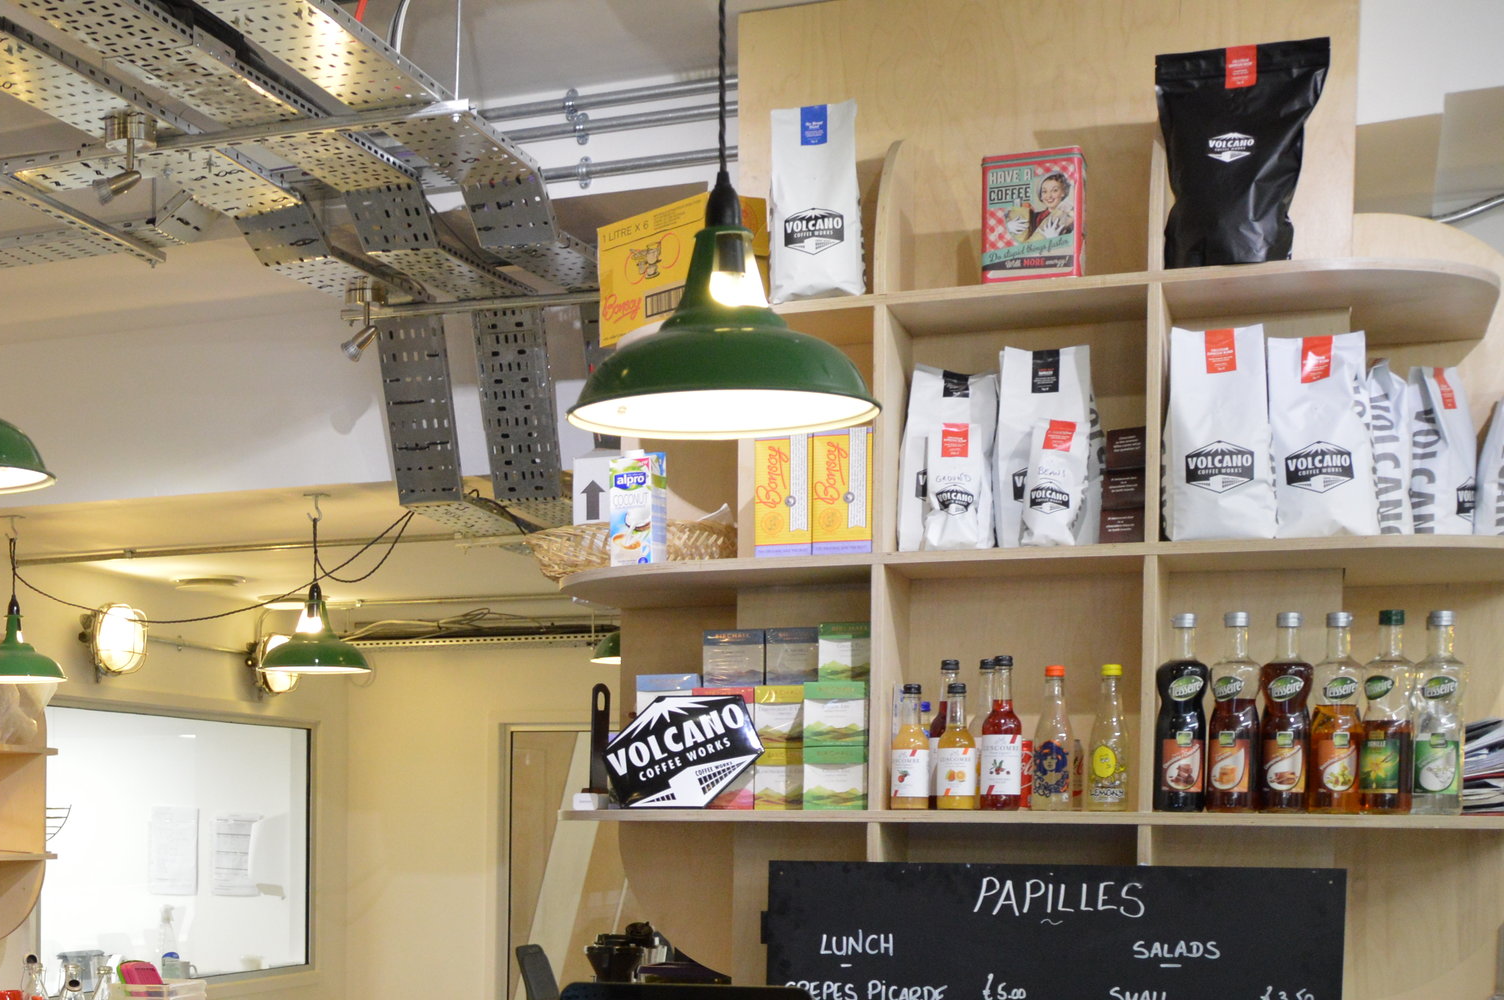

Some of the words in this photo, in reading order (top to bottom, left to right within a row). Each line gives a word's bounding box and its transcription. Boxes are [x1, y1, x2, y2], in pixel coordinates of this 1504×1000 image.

[1208, 138, 1254, 149] VOLCANO
[989, 169, 1020, 184] HAVE
[1023, 168, 1032, 180] A
[989, 186, 1031, 201] COFFEE
[785, 216, 843, 232] VOLCANO
[609, 227, 633, 243] LITRE
[814, 229, 834, 237] WORKS
[1023, 258, 1045, 267] MORE
[1187, 454, 1253, 470] VOLCANO
[1287, 453, 1351, 470] VOLCANO
[755, 445, 789, 509] Bonsoy
[813, 440, 848, 505] Bonsoy
[1221, 466, 1242, 474] WORKS
[1298, 468, 1321, 476] COFFEE
[1321, 466, 1343, 474] WORKS
[616, 473, 644, 487] alpro
[612, 493, 649, 507] COCONUT
[1031, 490, 1069, 502] VOLCANO
[1169, 678, 1205, 696] Teisseire
[1268, 678, 1305, 696] Teisseire
[606, 703, 745, 777] VOLCANO
[639, 757, 683, 781] COFFEE
[687, 736, 731, 762] WORKS
[695, 766, 715, 777] COFFEE
[973, 873, 1145, 918] PAPILLES
[819, 929, 894, 957] LUNCH
[1132, 940, 1221, 959] SALADS
